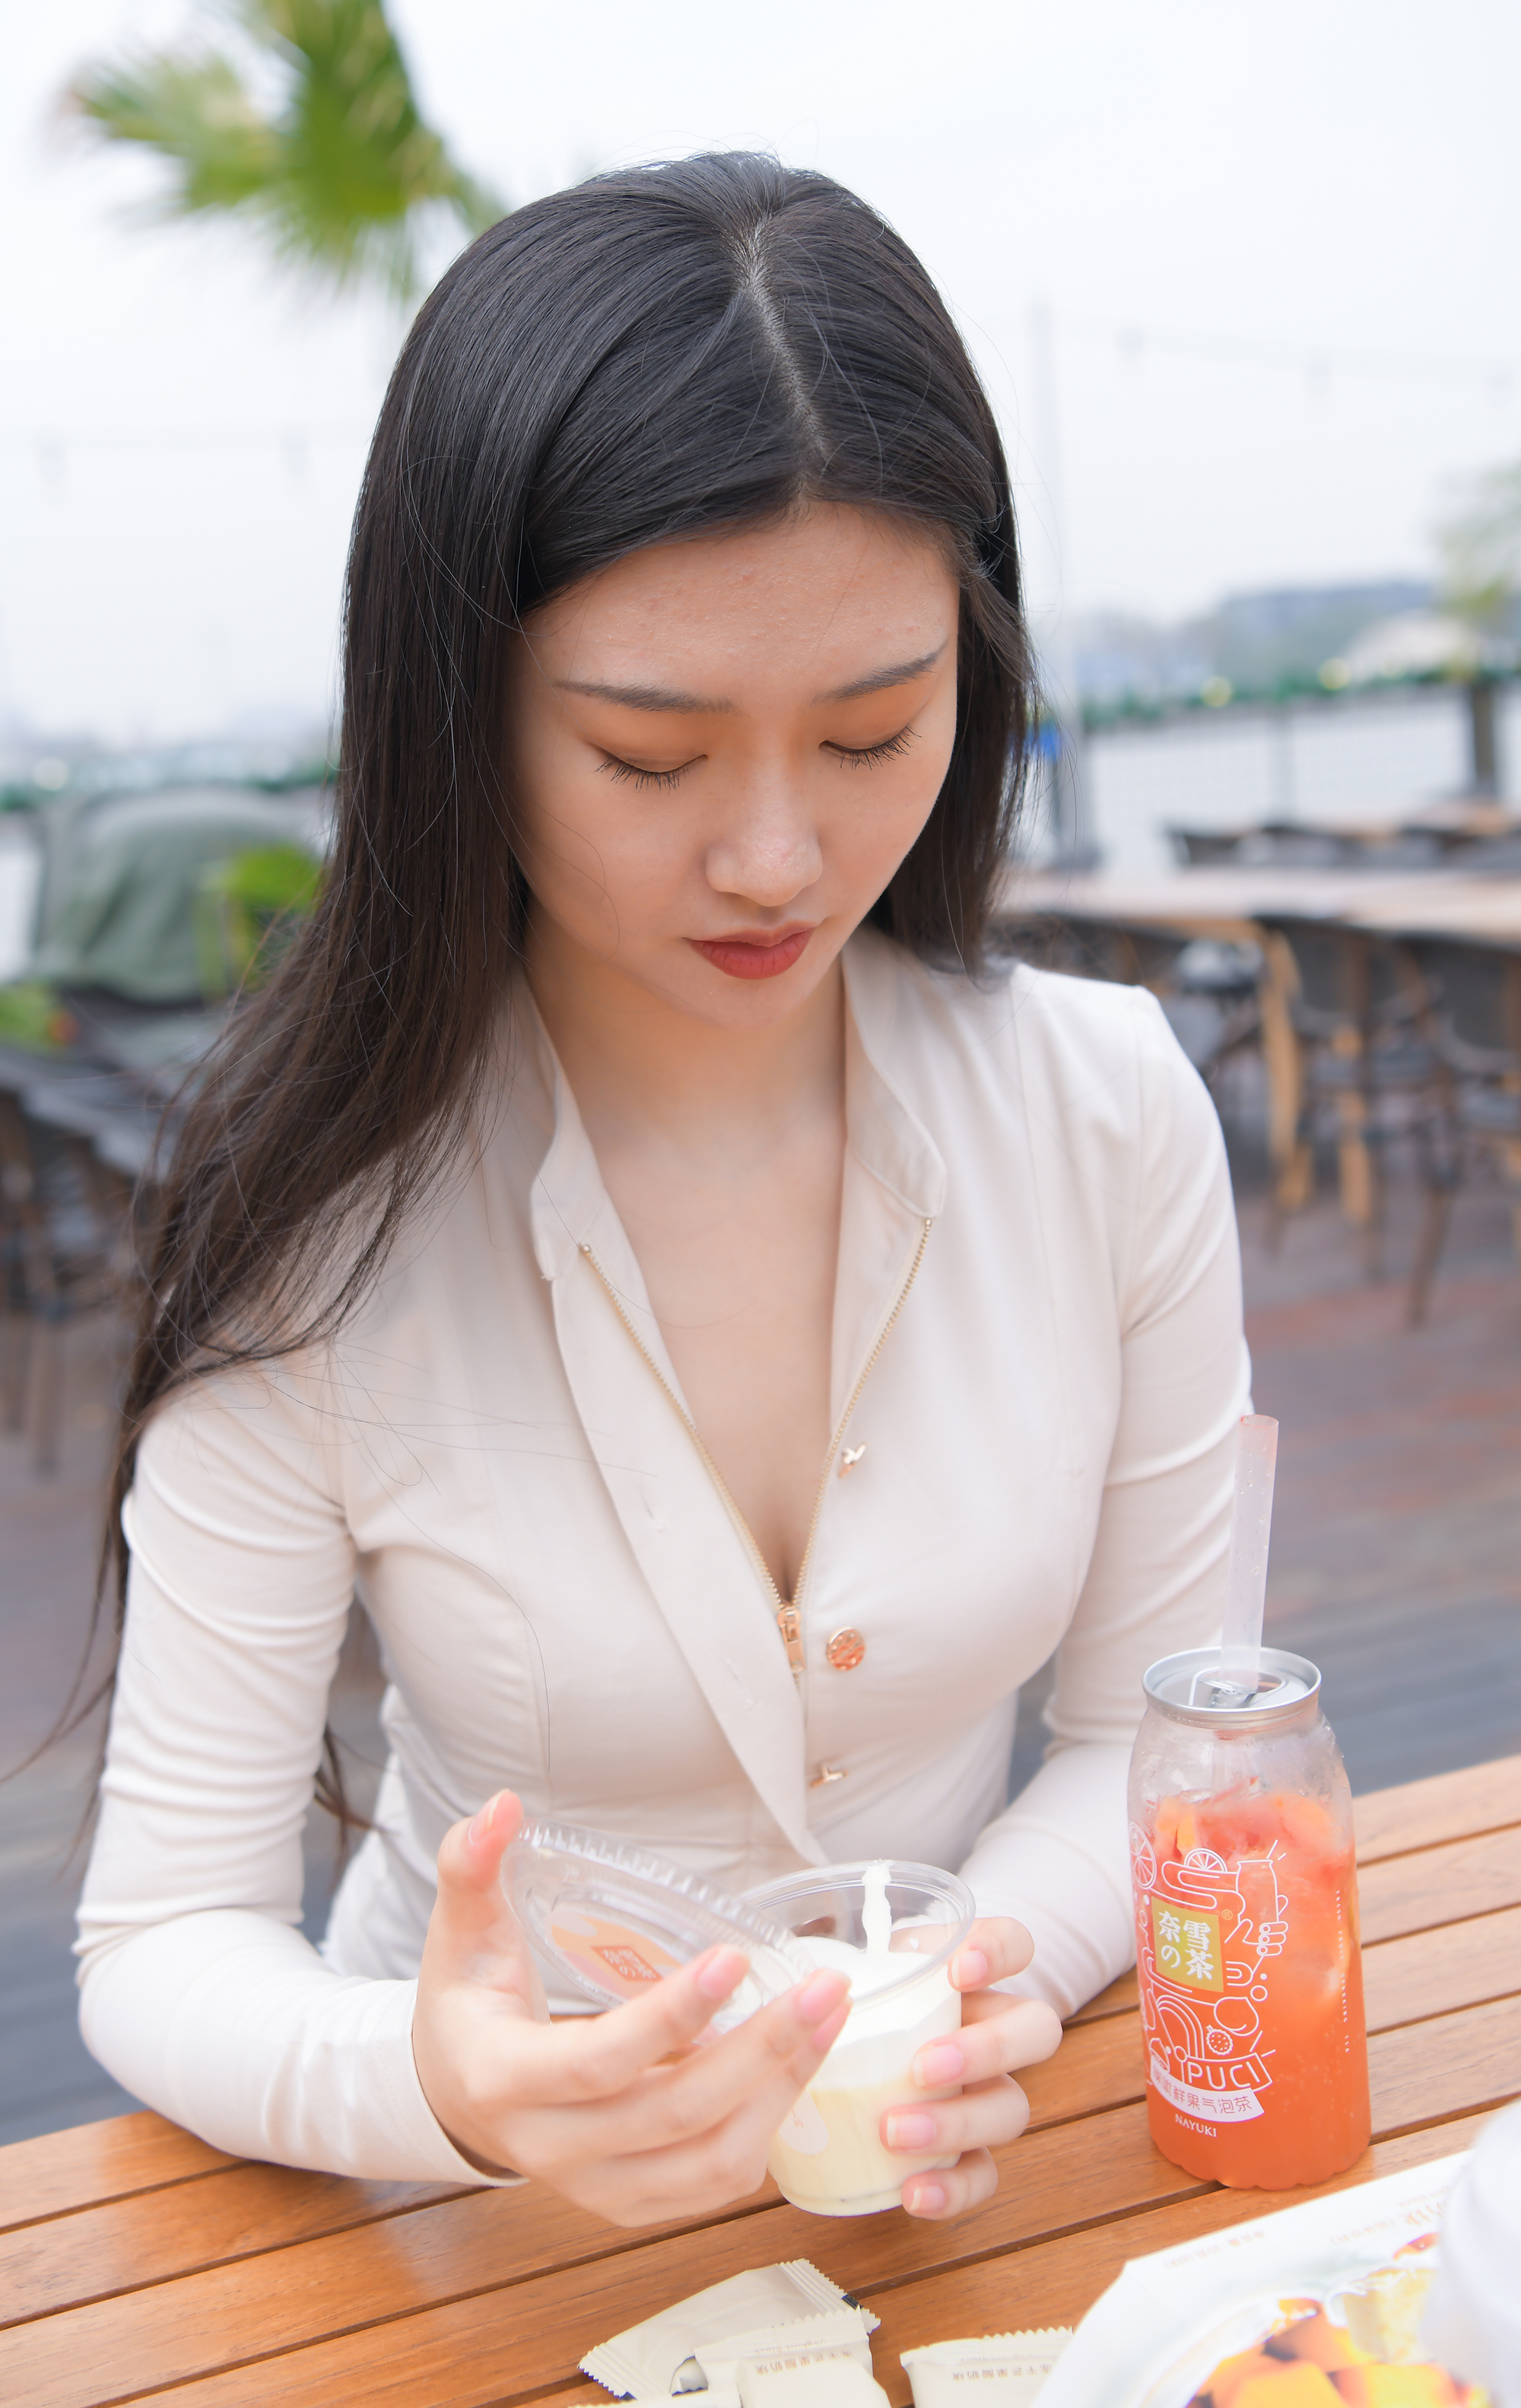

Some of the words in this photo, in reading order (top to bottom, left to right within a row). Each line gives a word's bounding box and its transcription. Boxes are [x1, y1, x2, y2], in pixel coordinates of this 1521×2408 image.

[1158, 1910, 1211, 1952] 奈雪
[1161, 1944, 1215, 1981] の茶
[1187, 2060, 1261, 2090] PUCI
[1174, 2113, 1218, 2138] NAYUKI
